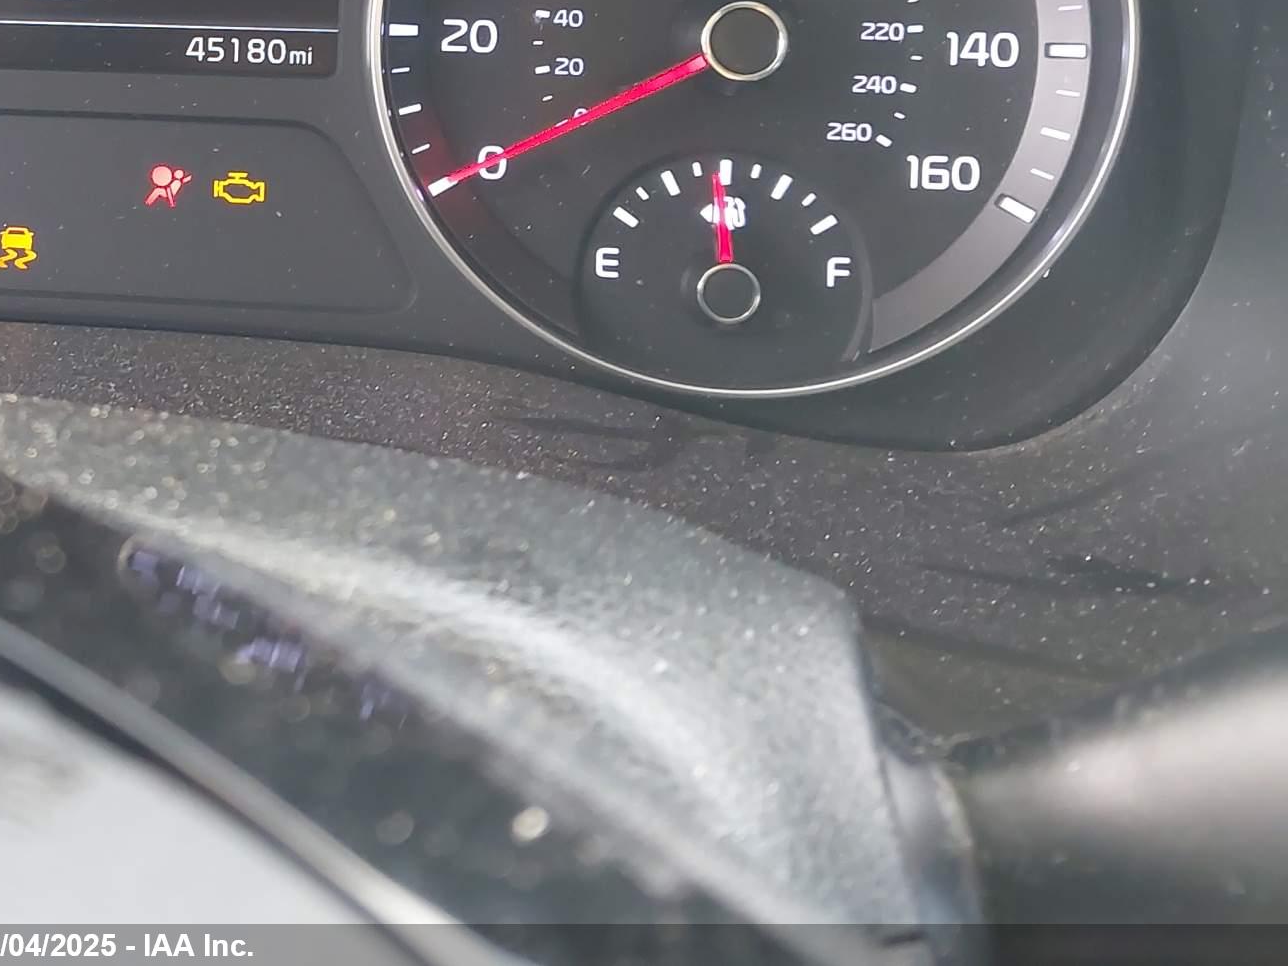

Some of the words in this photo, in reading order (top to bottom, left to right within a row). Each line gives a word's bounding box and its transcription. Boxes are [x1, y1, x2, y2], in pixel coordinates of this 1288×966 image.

[553, 9, 583, 28] 40
[860, 22, 905, 41] 220
[441, 18, 498, 54] 20
[947, 32, 1019, 68] 140
[554, 57, 584, 76] 20
[851, 75, 898, 95] 240
[826, 123, 872, 143] 260
[477, 146, 507, 180] 0
[908, 155, 980, 191] 160
[595, 248, 620, 279] E
[826, 258, 851, 287] F
